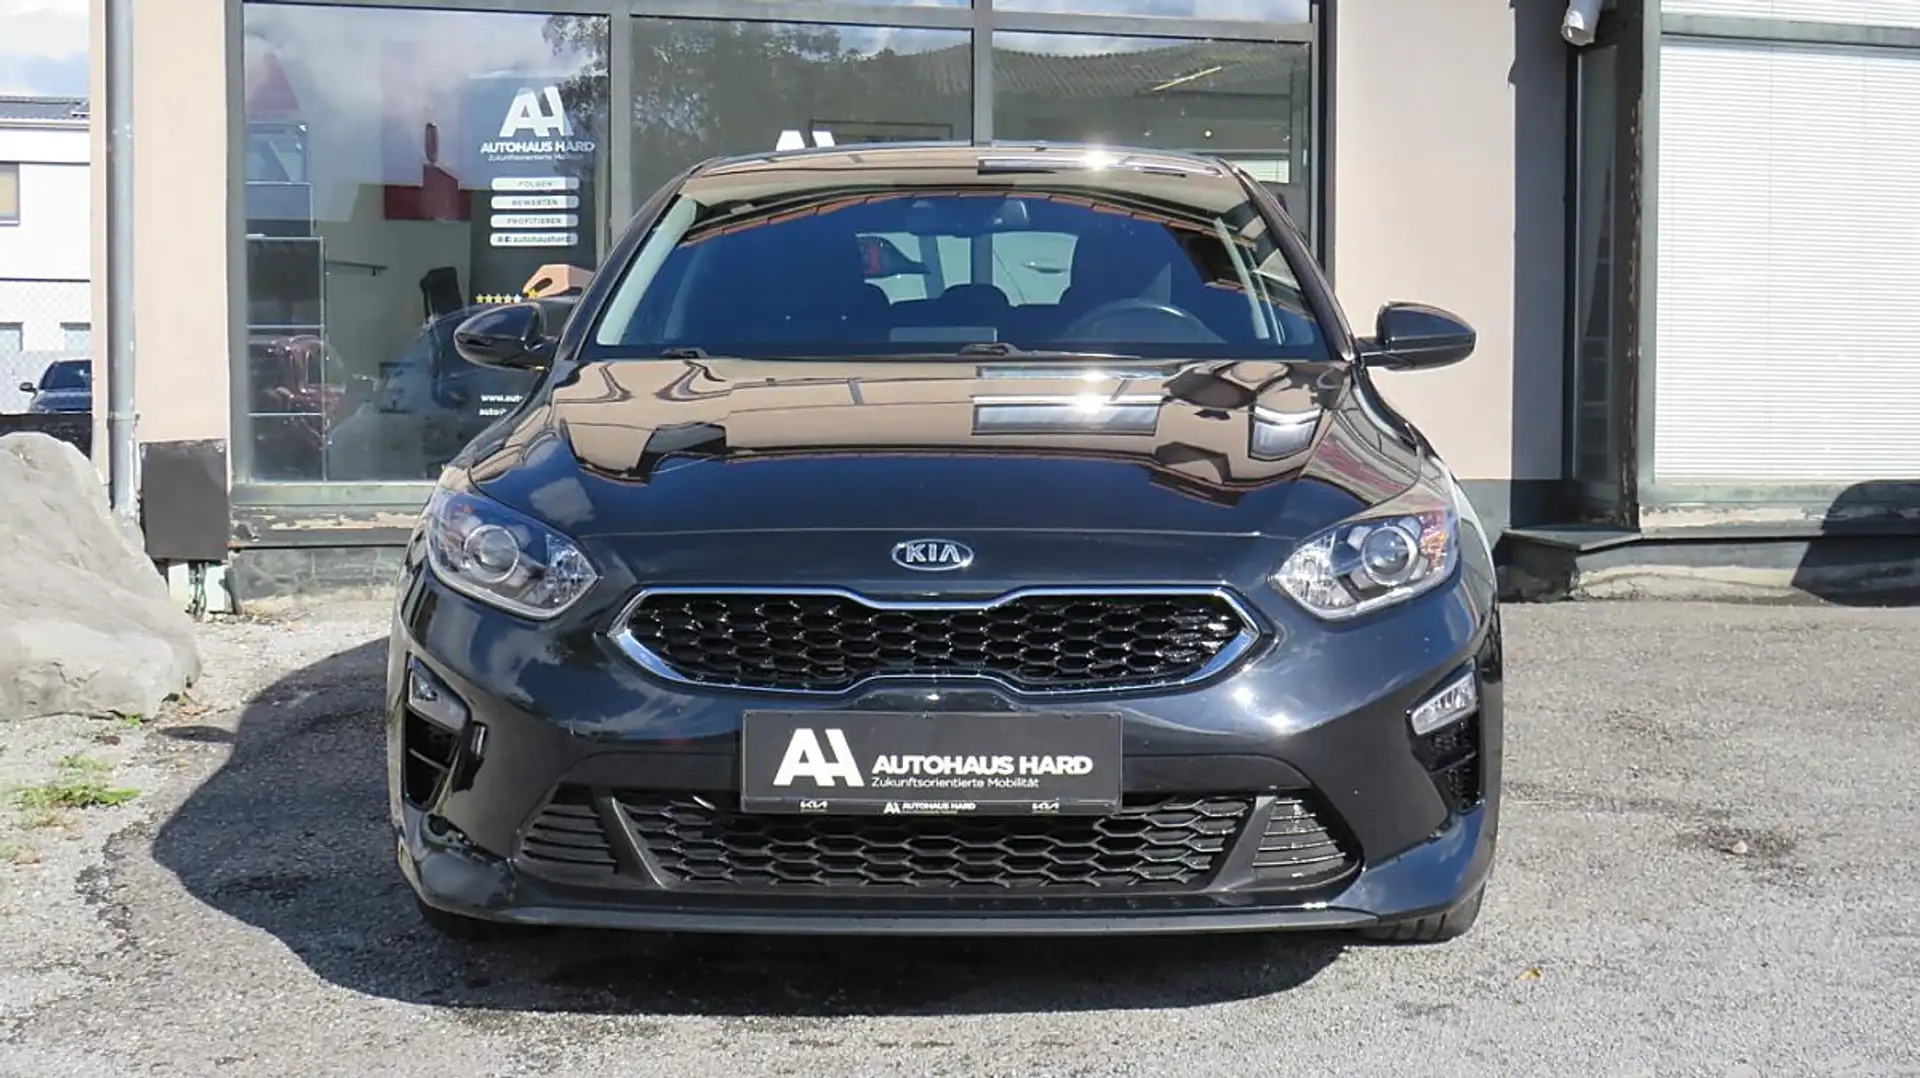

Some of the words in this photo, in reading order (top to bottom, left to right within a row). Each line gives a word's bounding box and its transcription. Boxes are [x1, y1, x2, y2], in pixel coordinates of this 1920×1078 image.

[480, 141, 553, 154] AUTOHAUS
[555, 141, 596, 153] HARD
[906, 543, 961, 562] KIA
[872, 755, 1014, 776] AUTOHAUS
[1019, 755, 1093, 775] HARD
[871, 776, 985, 788] Zukunftsorientierte
[987, 776, 1040, 788] Mobilität
[902, 802, 951, 811] AUTOHAUS
[951, 802, 977, 811] HARD
